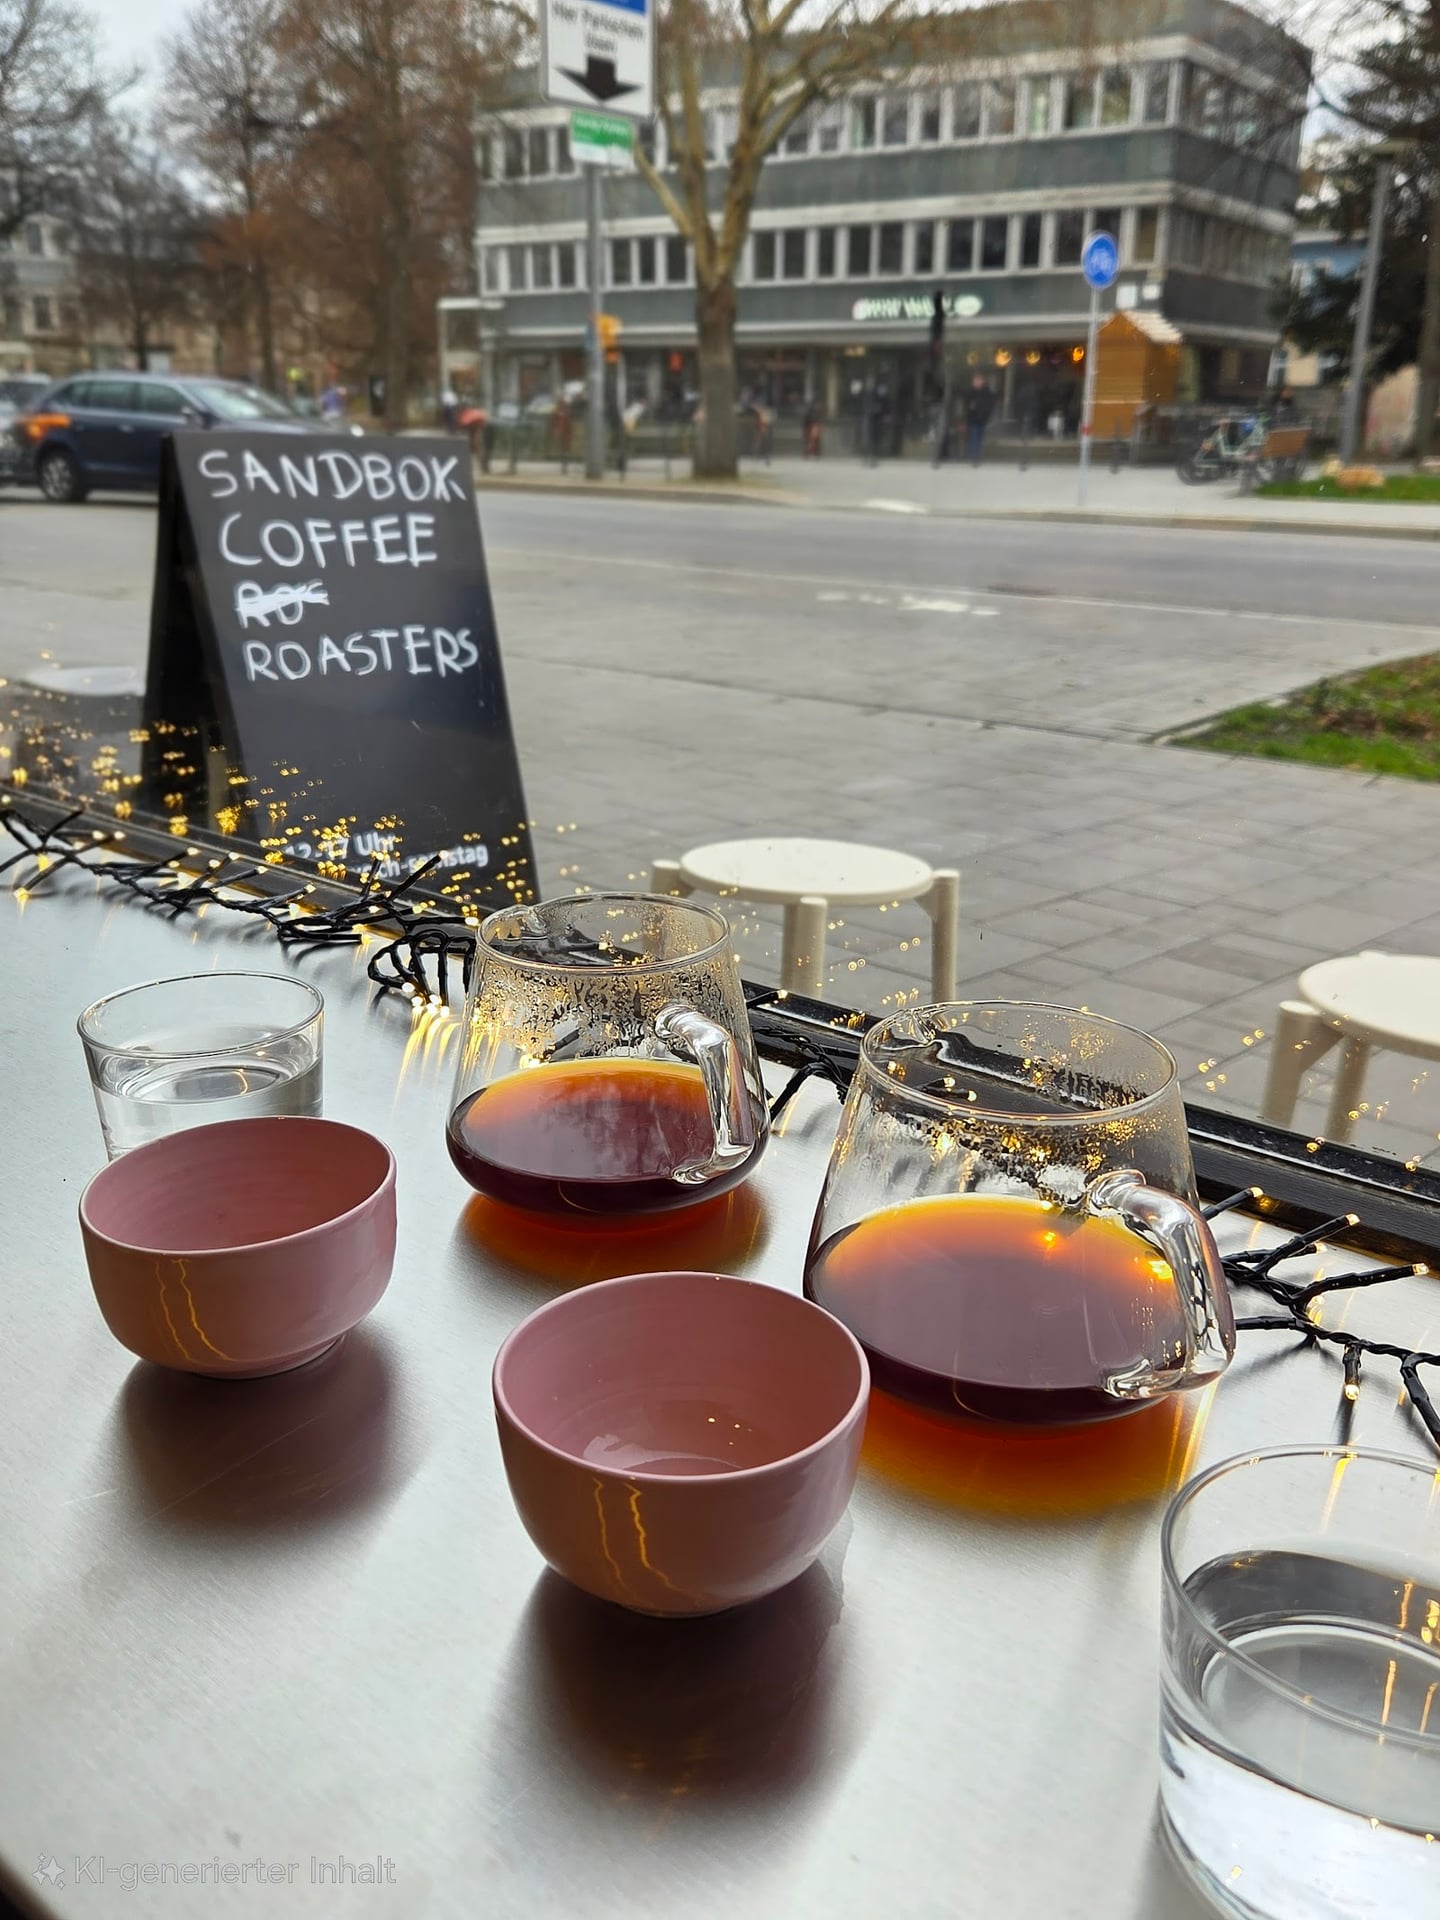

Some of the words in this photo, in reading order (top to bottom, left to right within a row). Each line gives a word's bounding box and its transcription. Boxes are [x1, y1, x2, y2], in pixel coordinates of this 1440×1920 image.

[218, 511, 439, 568] COFFEE
[243, 624, 479, 681] ROASTERS
[355, 831, 396, 856] Uhr
